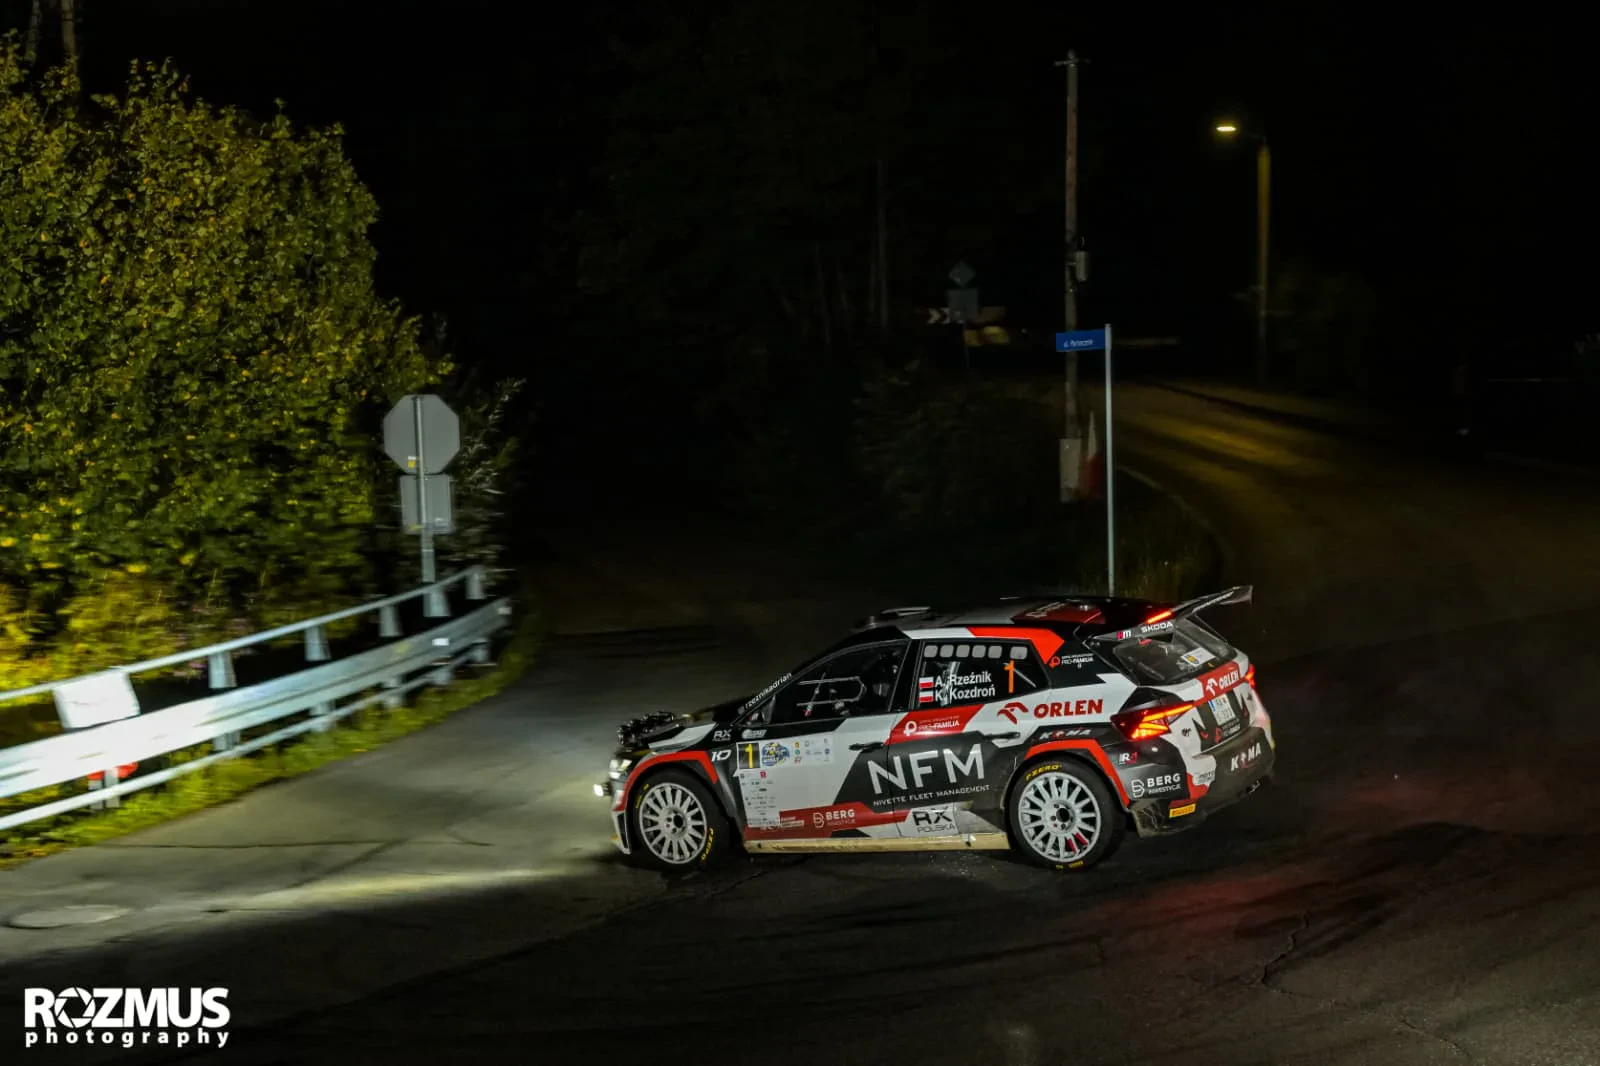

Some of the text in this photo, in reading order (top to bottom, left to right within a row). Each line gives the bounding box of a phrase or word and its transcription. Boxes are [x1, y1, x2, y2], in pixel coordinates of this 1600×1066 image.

[935, 670, 992, 688] A. Rzeźnik
[1004, 660, 1014, 693] 1
[935, 683, 996, 702] K. Kozdroń
[1033, 698, 1104, 719] ORLEN
[745, 743, 754, 769] 1
[867, 743, 985, 795] NFM
[1147, 772, 1181, 788] BERG
[873, 784, 991, 806] NIVETTE FLEET MANAGEMENT
[825, 809, 855, 821] BERG
[917, 823, 956, 833] POLSKA
